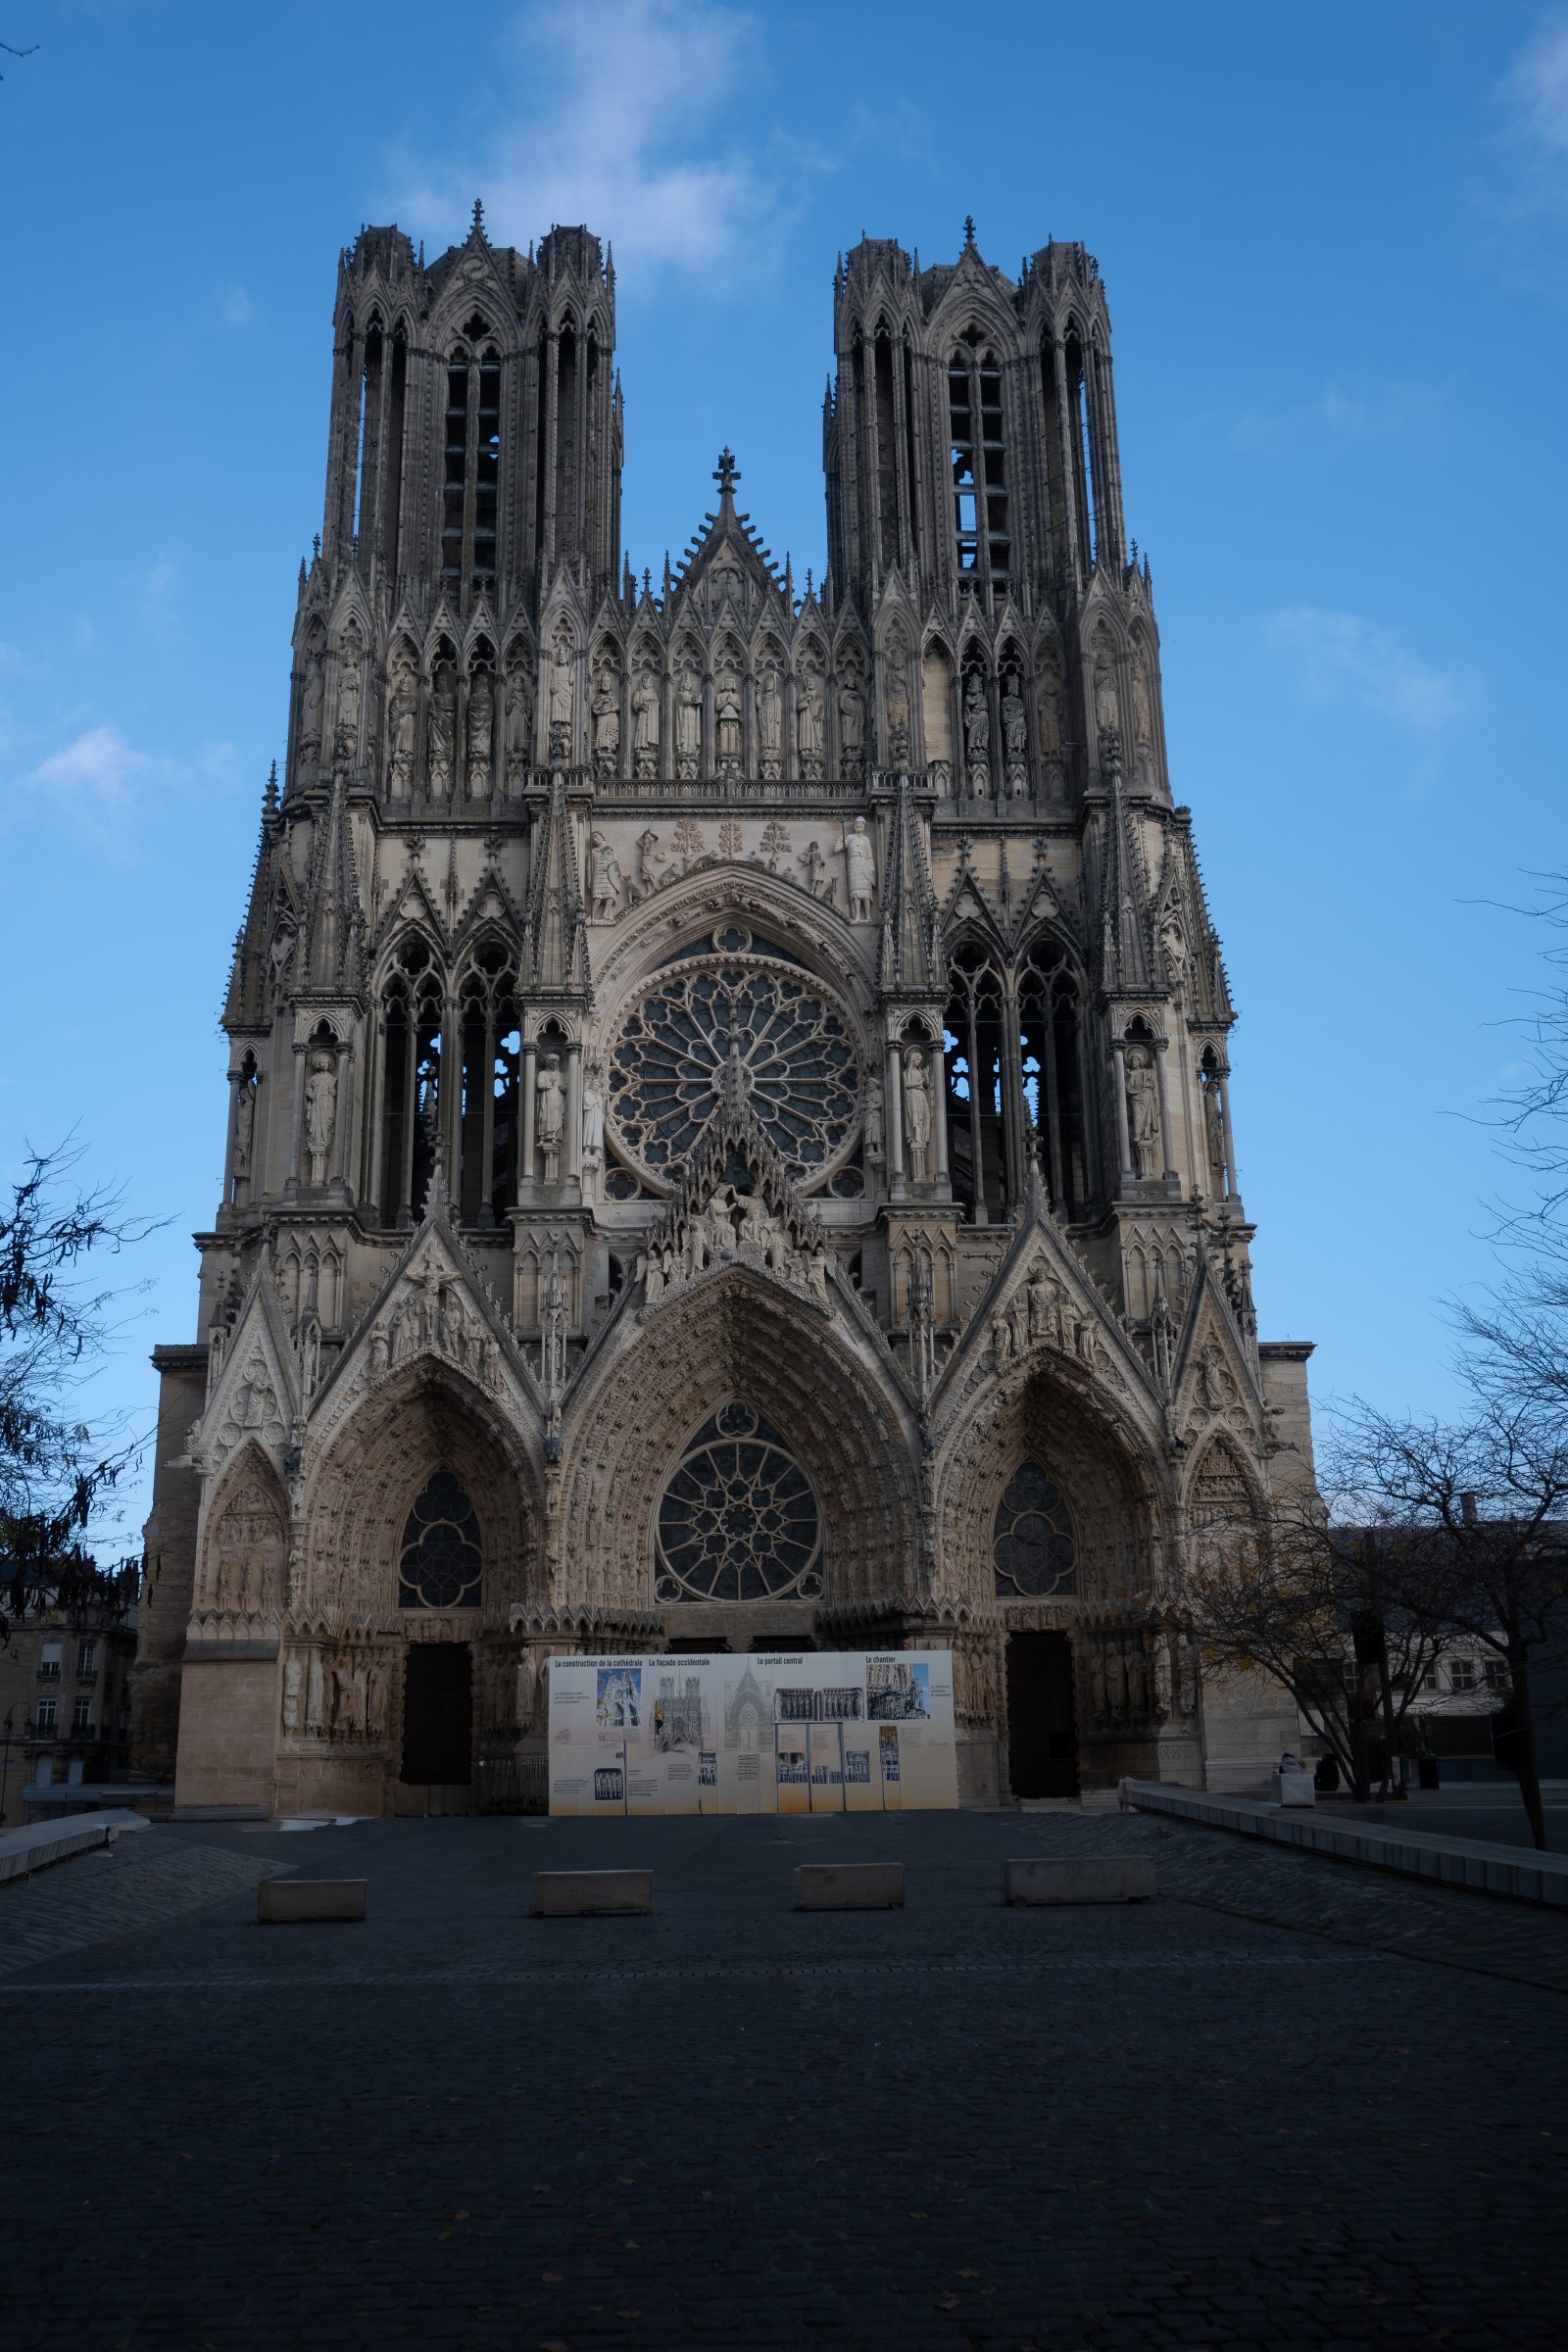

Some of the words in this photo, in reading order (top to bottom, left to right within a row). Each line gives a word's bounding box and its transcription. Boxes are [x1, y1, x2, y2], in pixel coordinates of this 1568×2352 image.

[563, 1659, 598, 1668] construction
[656, 1658, 676, 1669] façade
[764, 1657, 782, 1666] portail
[783, 1657, 803, 1665] central
